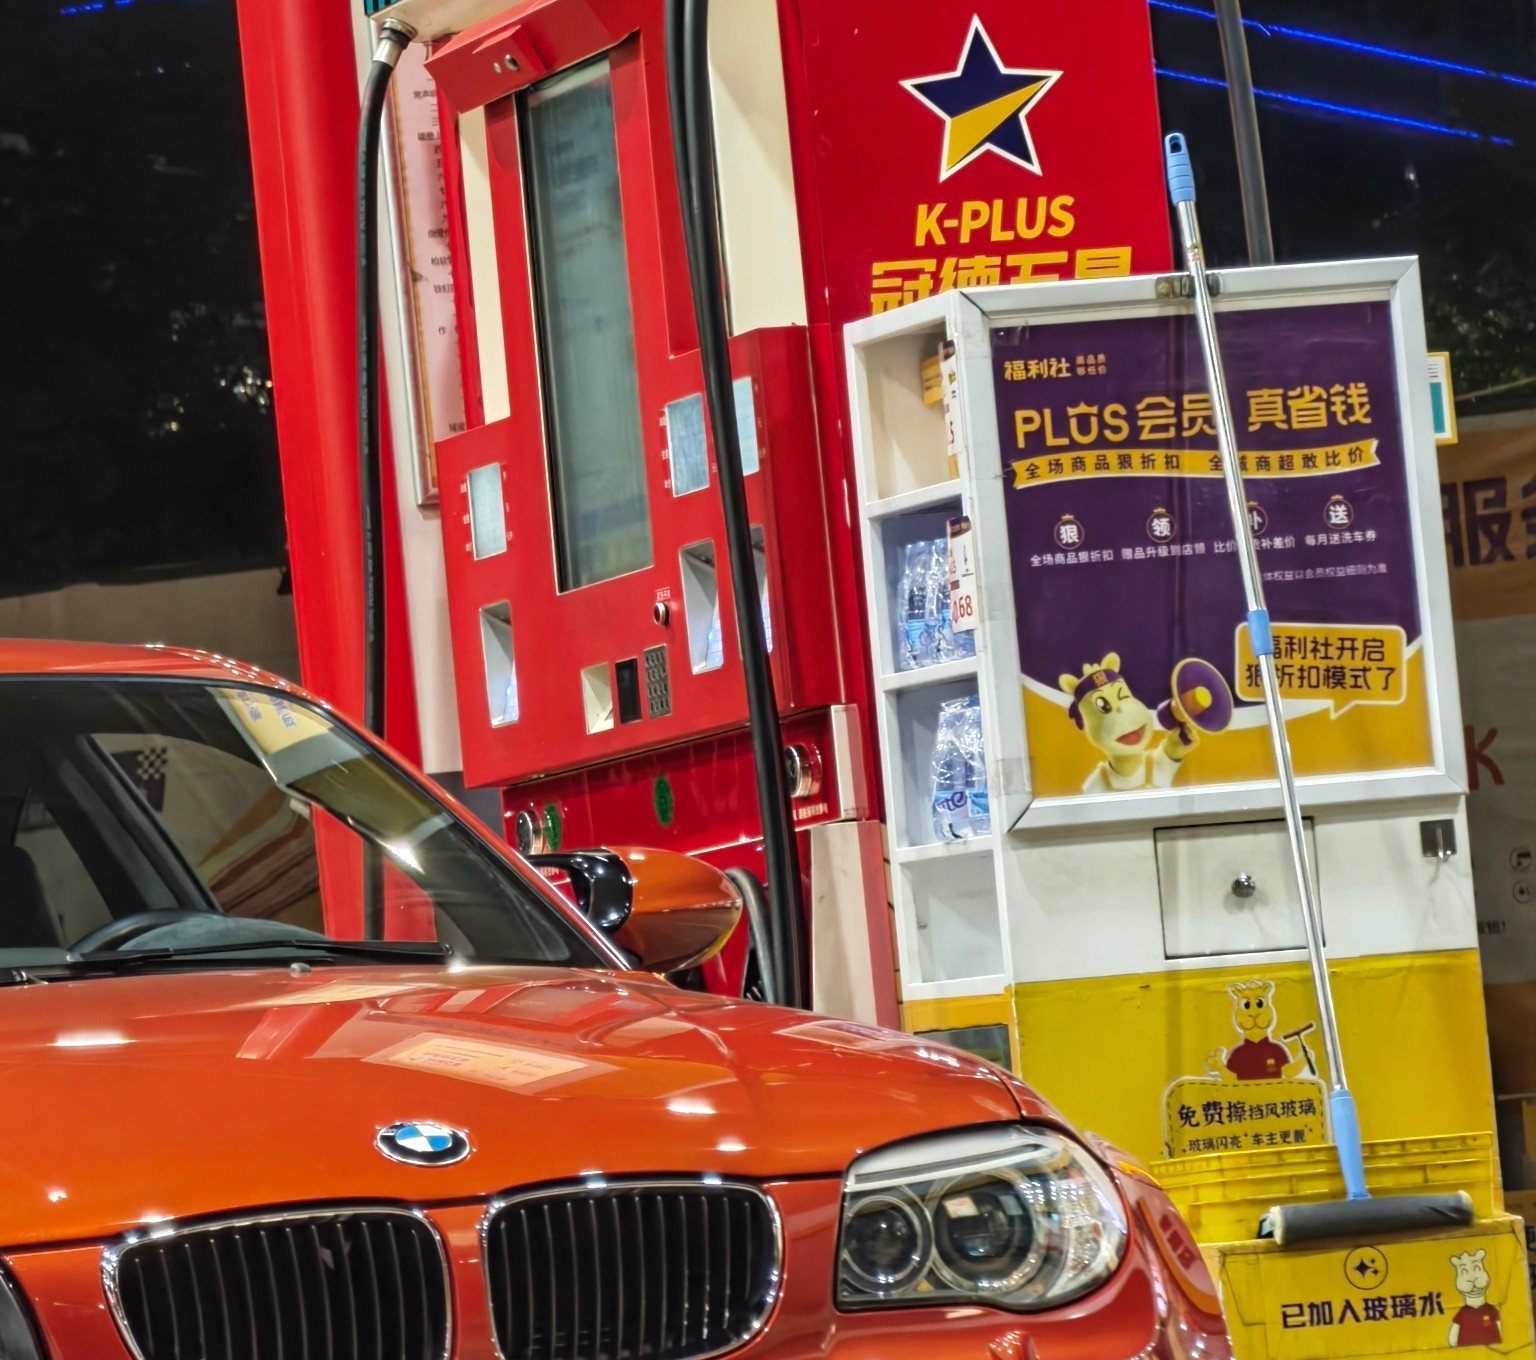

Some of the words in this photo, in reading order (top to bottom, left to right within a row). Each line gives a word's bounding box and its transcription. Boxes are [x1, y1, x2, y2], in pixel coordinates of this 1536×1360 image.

[915, 195, 1075, 246] K-PLUS
[1003, 357, 1072, 381] 福利社
[1246, 382, 1372, 433] 真省钱
[1025, 453, 1180, 480] 全场商品狠折扣
[1151, 517, 1171, 537] 领
[1328, 503, 1349, 524] 送
[1441, 476, 1536, 568] 服
[1059, 524, 1079, 544] 狠
[1177, 1098, 1317, 1129] 免费擦挡风玻璃
[1189, 1134, 1242, 1153] 玻璃闪亮
[1280, 1291, 1446, 1330] 已加入玻璃水
